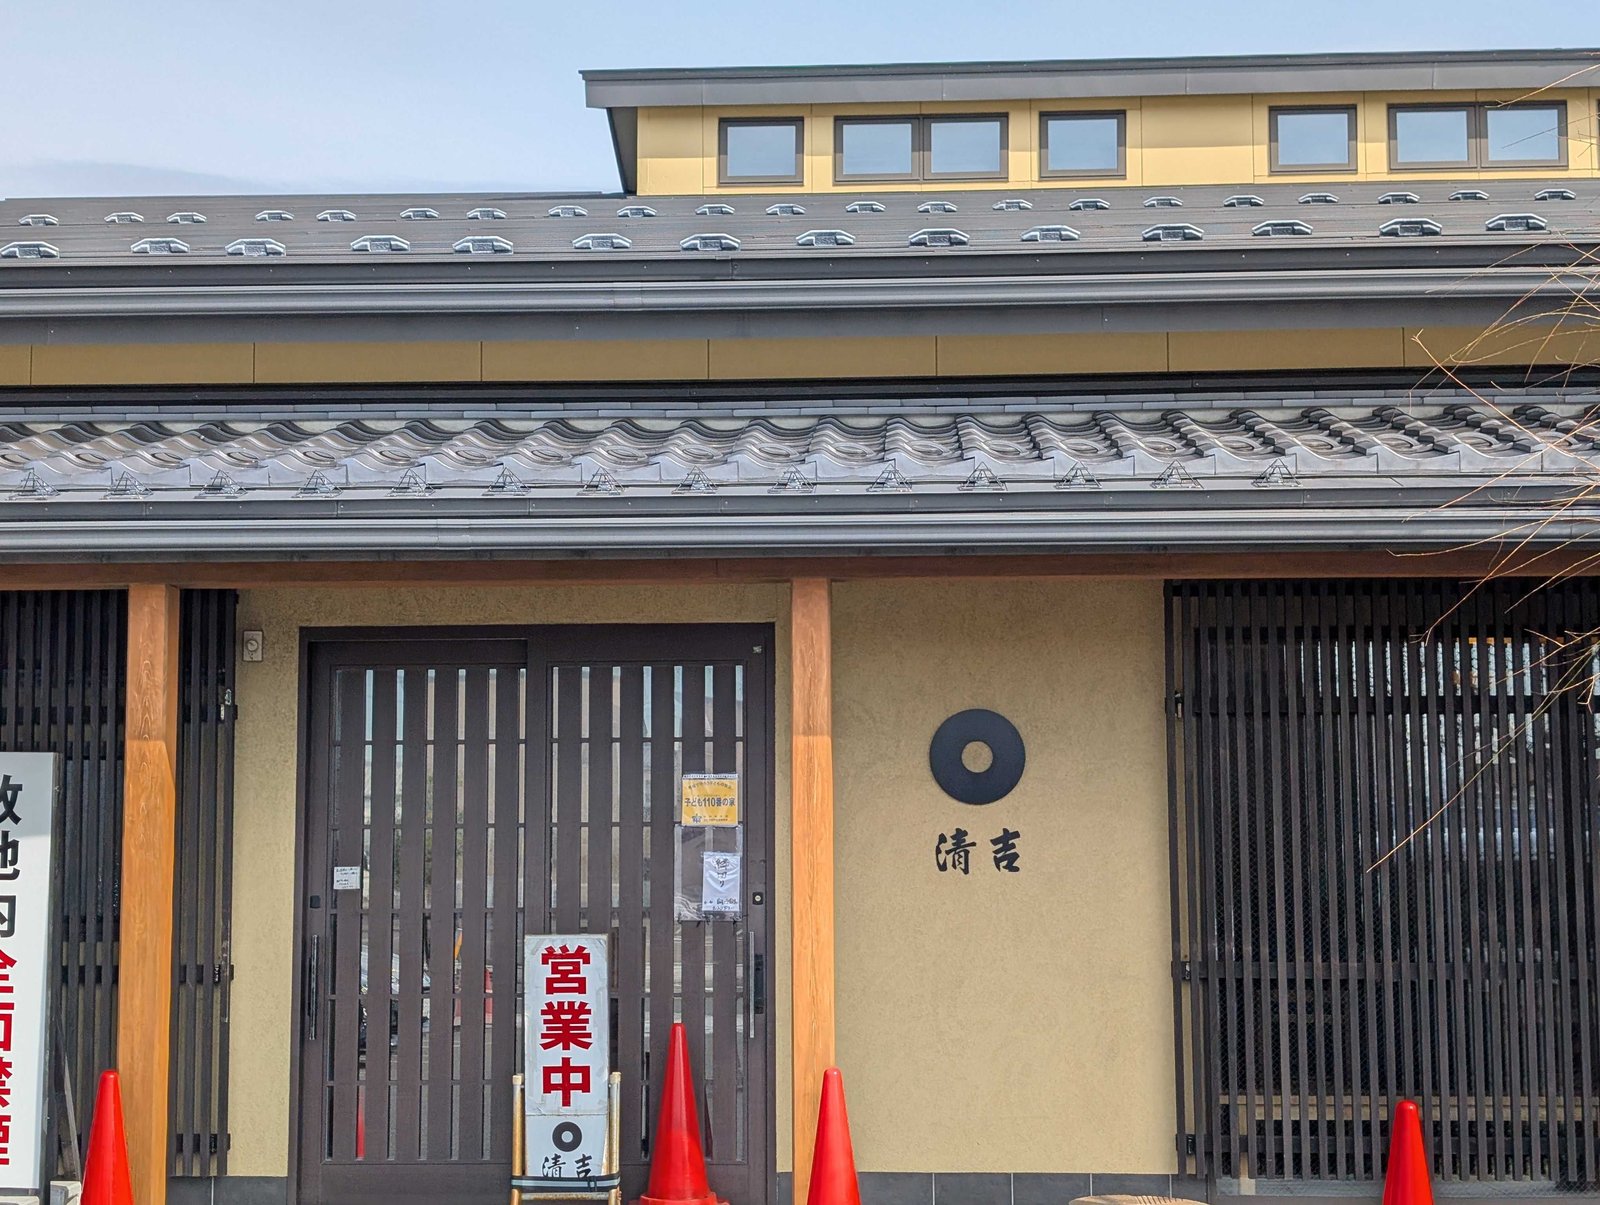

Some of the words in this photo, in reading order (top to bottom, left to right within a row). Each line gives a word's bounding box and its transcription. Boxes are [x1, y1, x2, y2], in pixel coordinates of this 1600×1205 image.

[935, 827, 1021, 875] 清吉
[539, 944, 593, 1107] 営業中
[542, 1153, 592, 1178] 清吉
